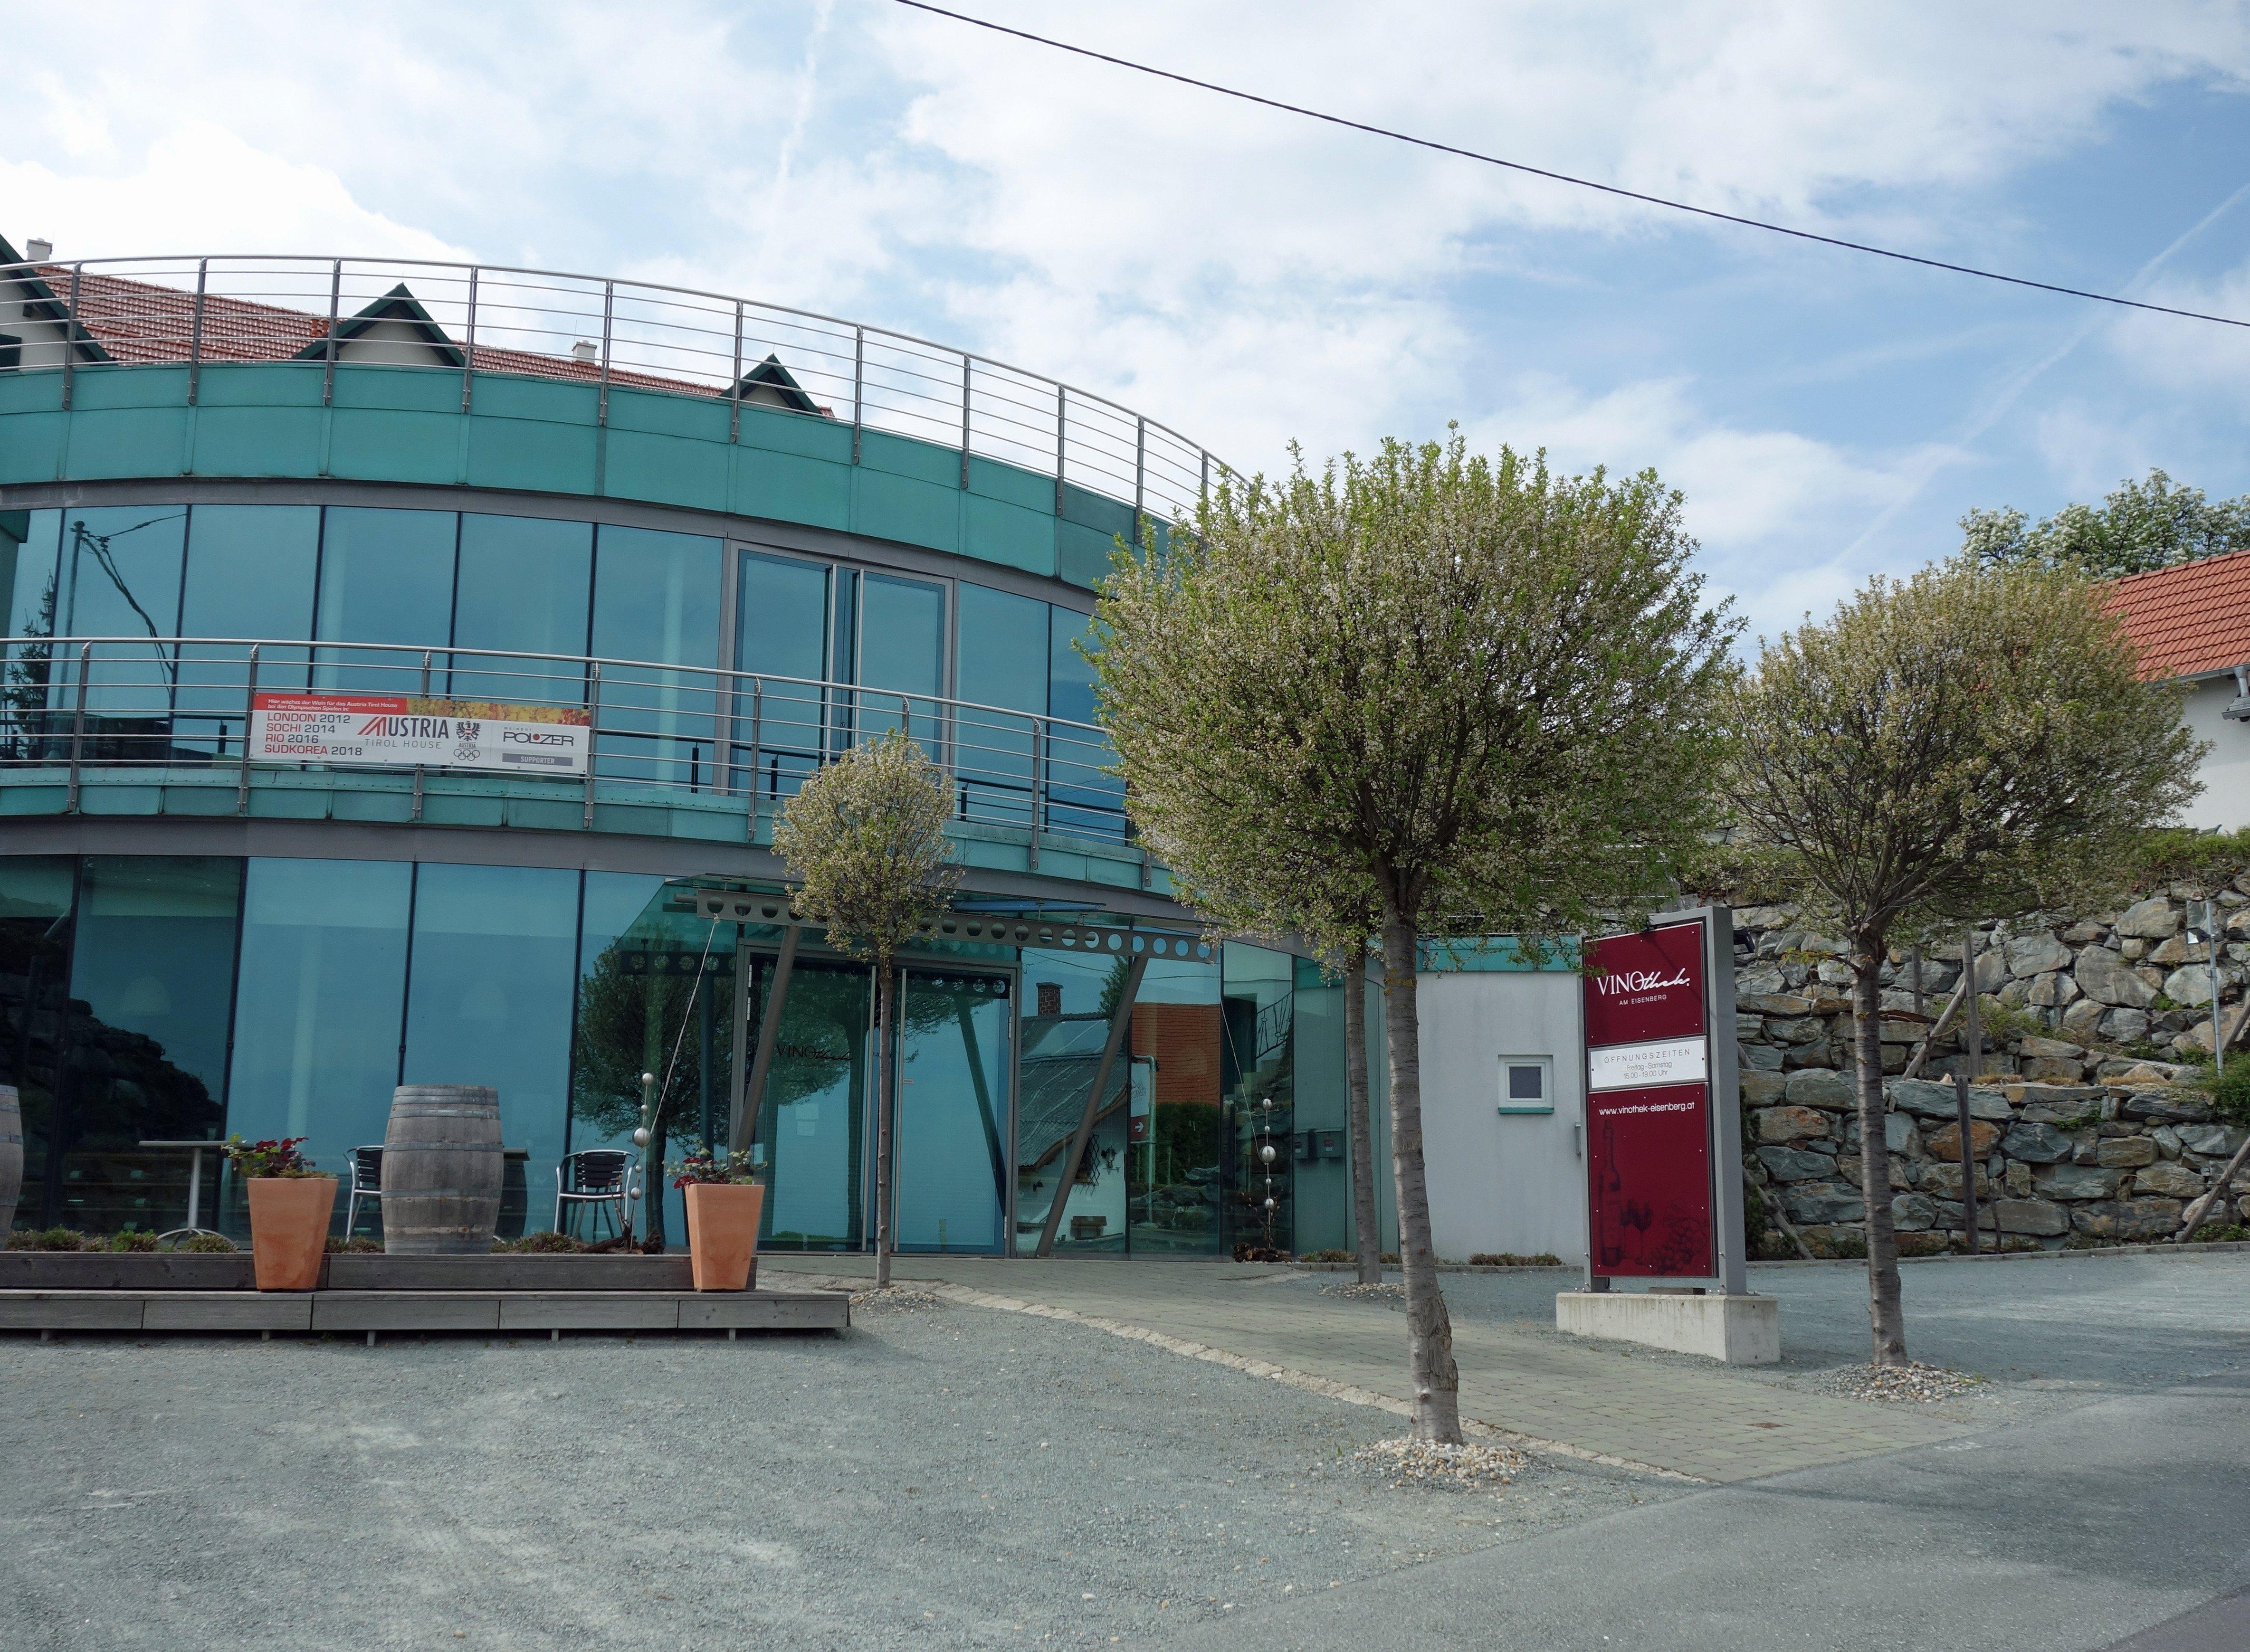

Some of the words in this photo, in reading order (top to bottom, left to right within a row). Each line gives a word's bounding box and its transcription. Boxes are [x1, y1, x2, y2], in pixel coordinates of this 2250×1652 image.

[267, 713, 316, 722] LONDON
[320, 714, 351, 724] 2012
[266, 723, 301, 732] SOCHI
[305, 724, 335, 733] 2014
[357, 716, 449, 739] AUSTRIA
[265, 734, 284, 742] RIO
[288, 735, 319, 744] 2016
[365, 739, 397, 747] TIROL
[404, 741, 441, 749] HOUSE
[503, 731, 574, 746] POLZER
[265, 743, 328, 755] SÜDKOREA
[331, 747, 362, 756] 2018
[521, 756, 554, 764] SUPPORTER
[1631, 994, 1667, 1005] EISENBERG
[1604, 1049, 1690, 1063] ÖFFNUNGSZEITEN
[1599, 1101, 1695, 1115] www.vinothek-eisenberg.at
